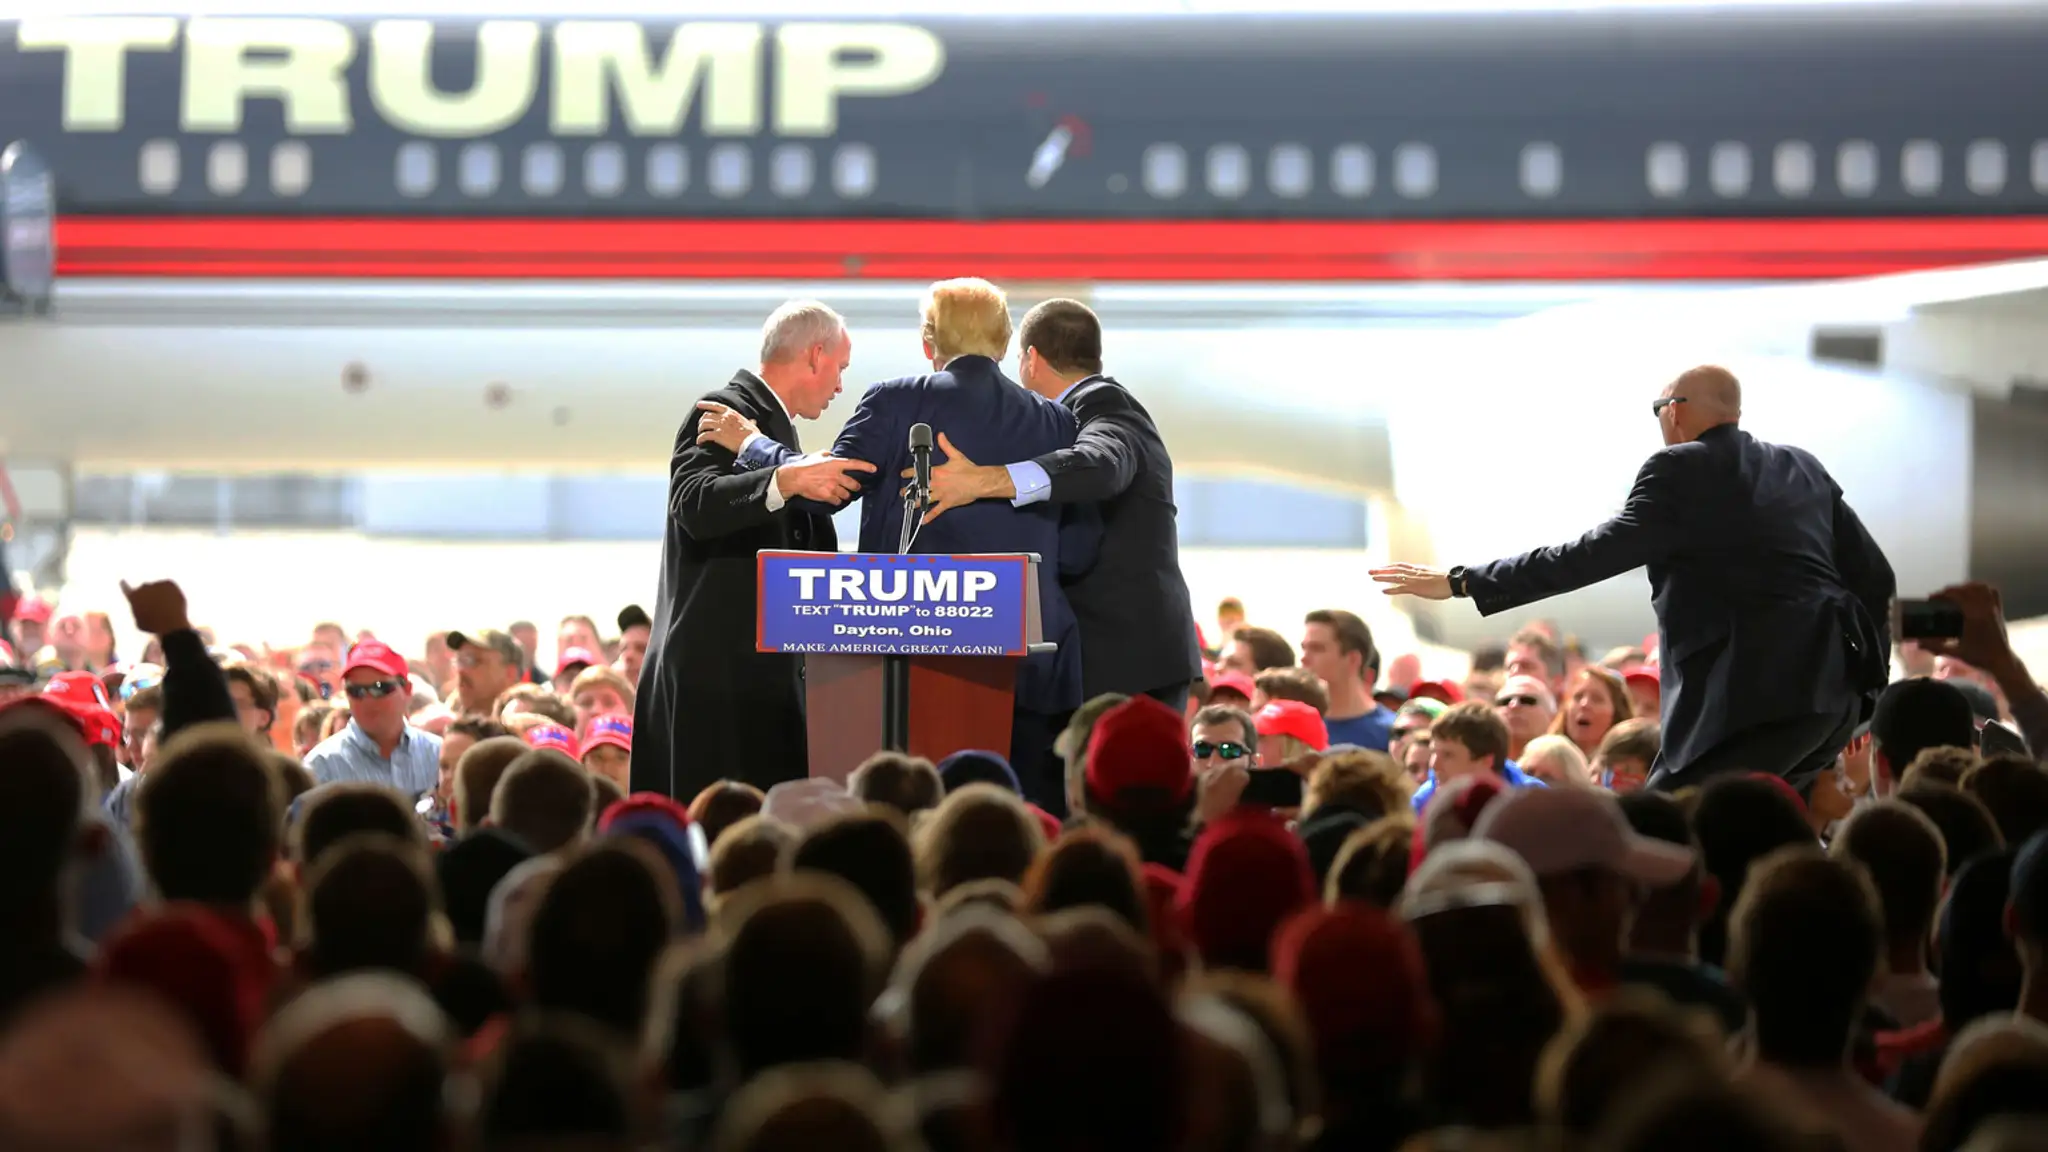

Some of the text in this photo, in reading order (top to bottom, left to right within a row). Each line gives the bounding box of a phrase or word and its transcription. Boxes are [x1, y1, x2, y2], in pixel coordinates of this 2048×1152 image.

[16, 17, 945, 137] TRUMP
[788, 568, 998, 603] TRUMP
[792, 605, 832, 616] TEXT
[915, 607, 931, 617] to
[934, 606, 994, 618] 88022
[833, 624, 953, 638] Dayton, Ohio
[783, 643, 1003, 655] MAKE AMERICA GREAT AGAIN!
